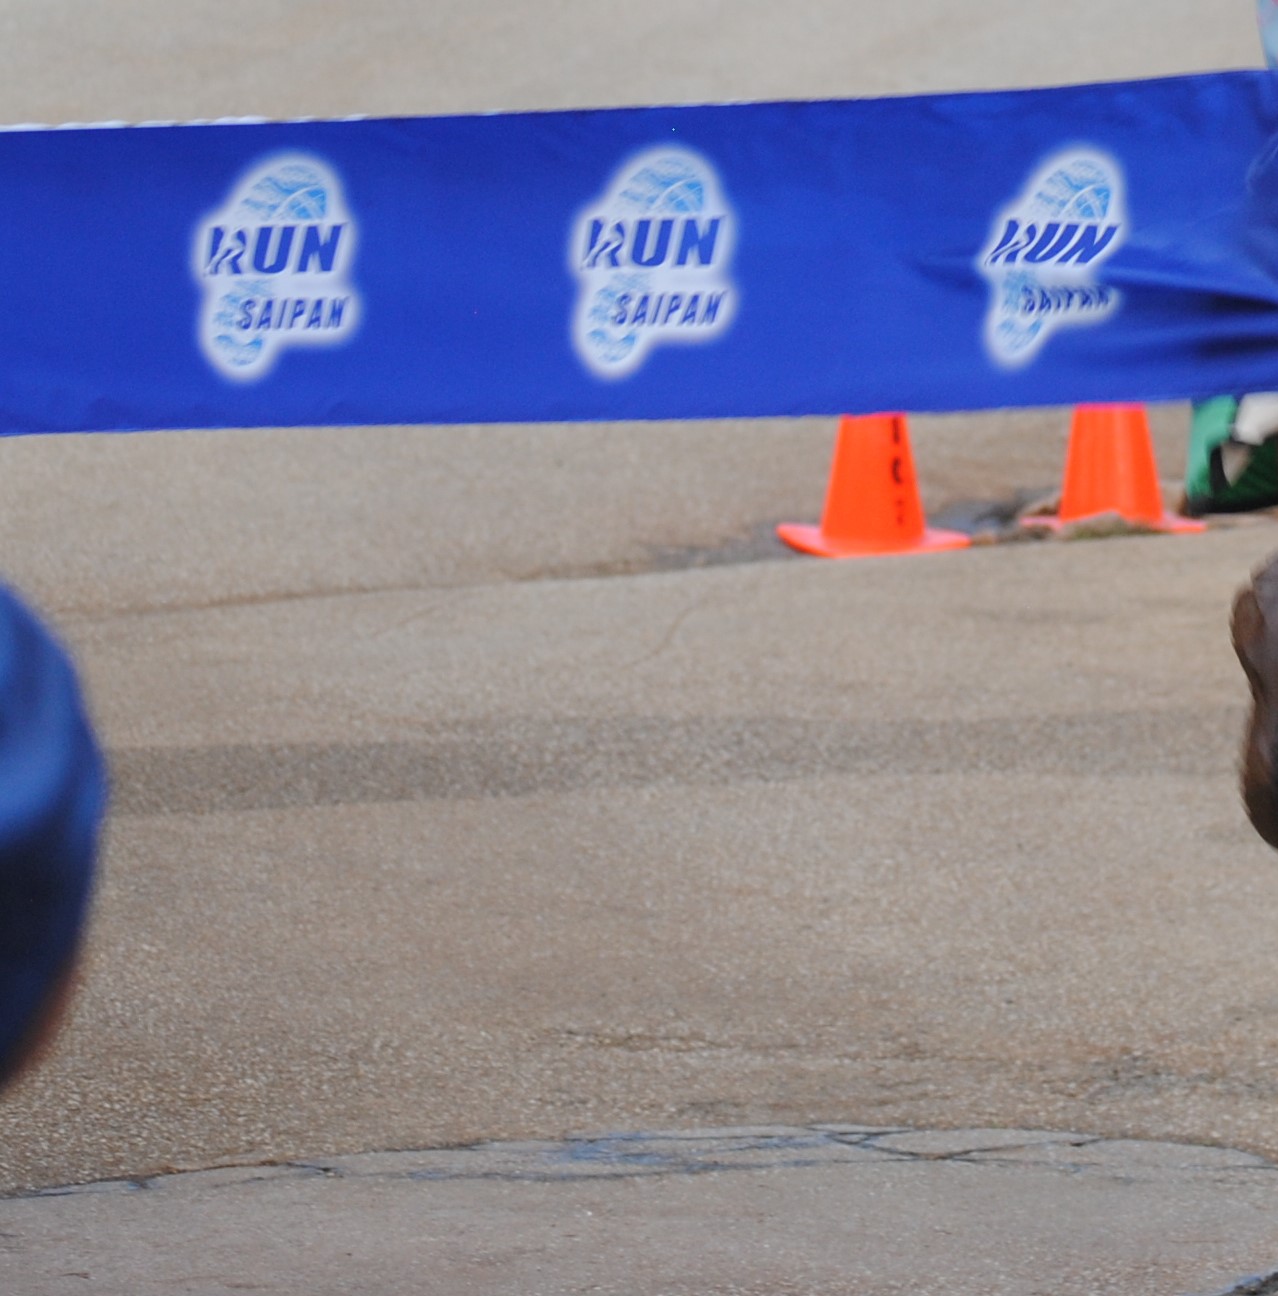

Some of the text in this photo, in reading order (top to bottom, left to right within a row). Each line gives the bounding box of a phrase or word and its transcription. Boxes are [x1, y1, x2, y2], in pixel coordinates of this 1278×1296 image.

[204, 223, 347, 276] RUN
[582, 215, 727, 269] RUN
[985, 219, 1121, 267] RUN
[236, 296, 349, 331] SAIPAN
[612, 291, 727, 326] SAIPAN
